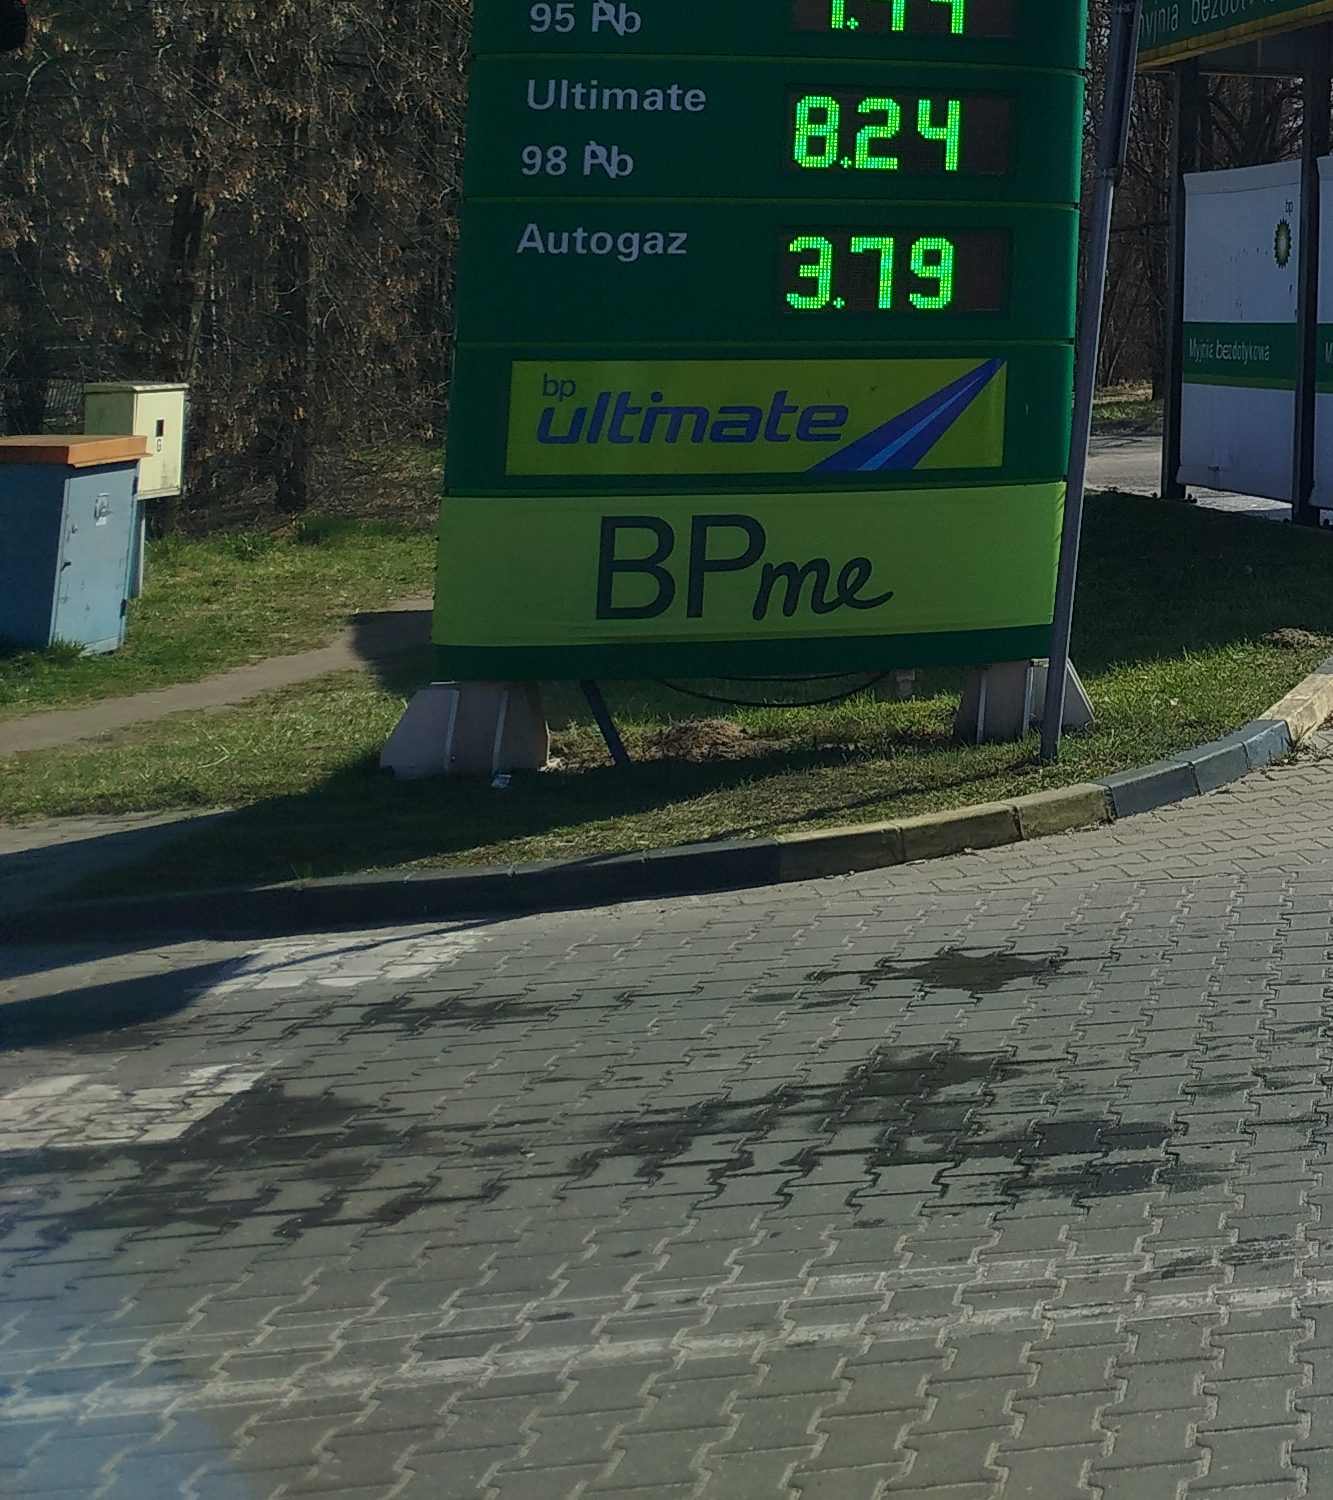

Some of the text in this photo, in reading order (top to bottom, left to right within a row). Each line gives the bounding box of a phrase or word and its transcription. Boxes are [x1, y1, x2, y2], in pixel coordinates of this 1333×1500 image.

[530, 3, 576, 33] 95
[527, 79, 706, 112] Ultimate
[792, 95, 961, 171] 8.24
[521, 145, 568, 176] 98
[516, 223, 688, 261] Autogaz
[786, 236, 954, 309] 3.79
[1216, 339, 1270, 366] bezdotykowa
[541, 373, 577, 402] bp
[537, 390, 849, 444] ultimate
